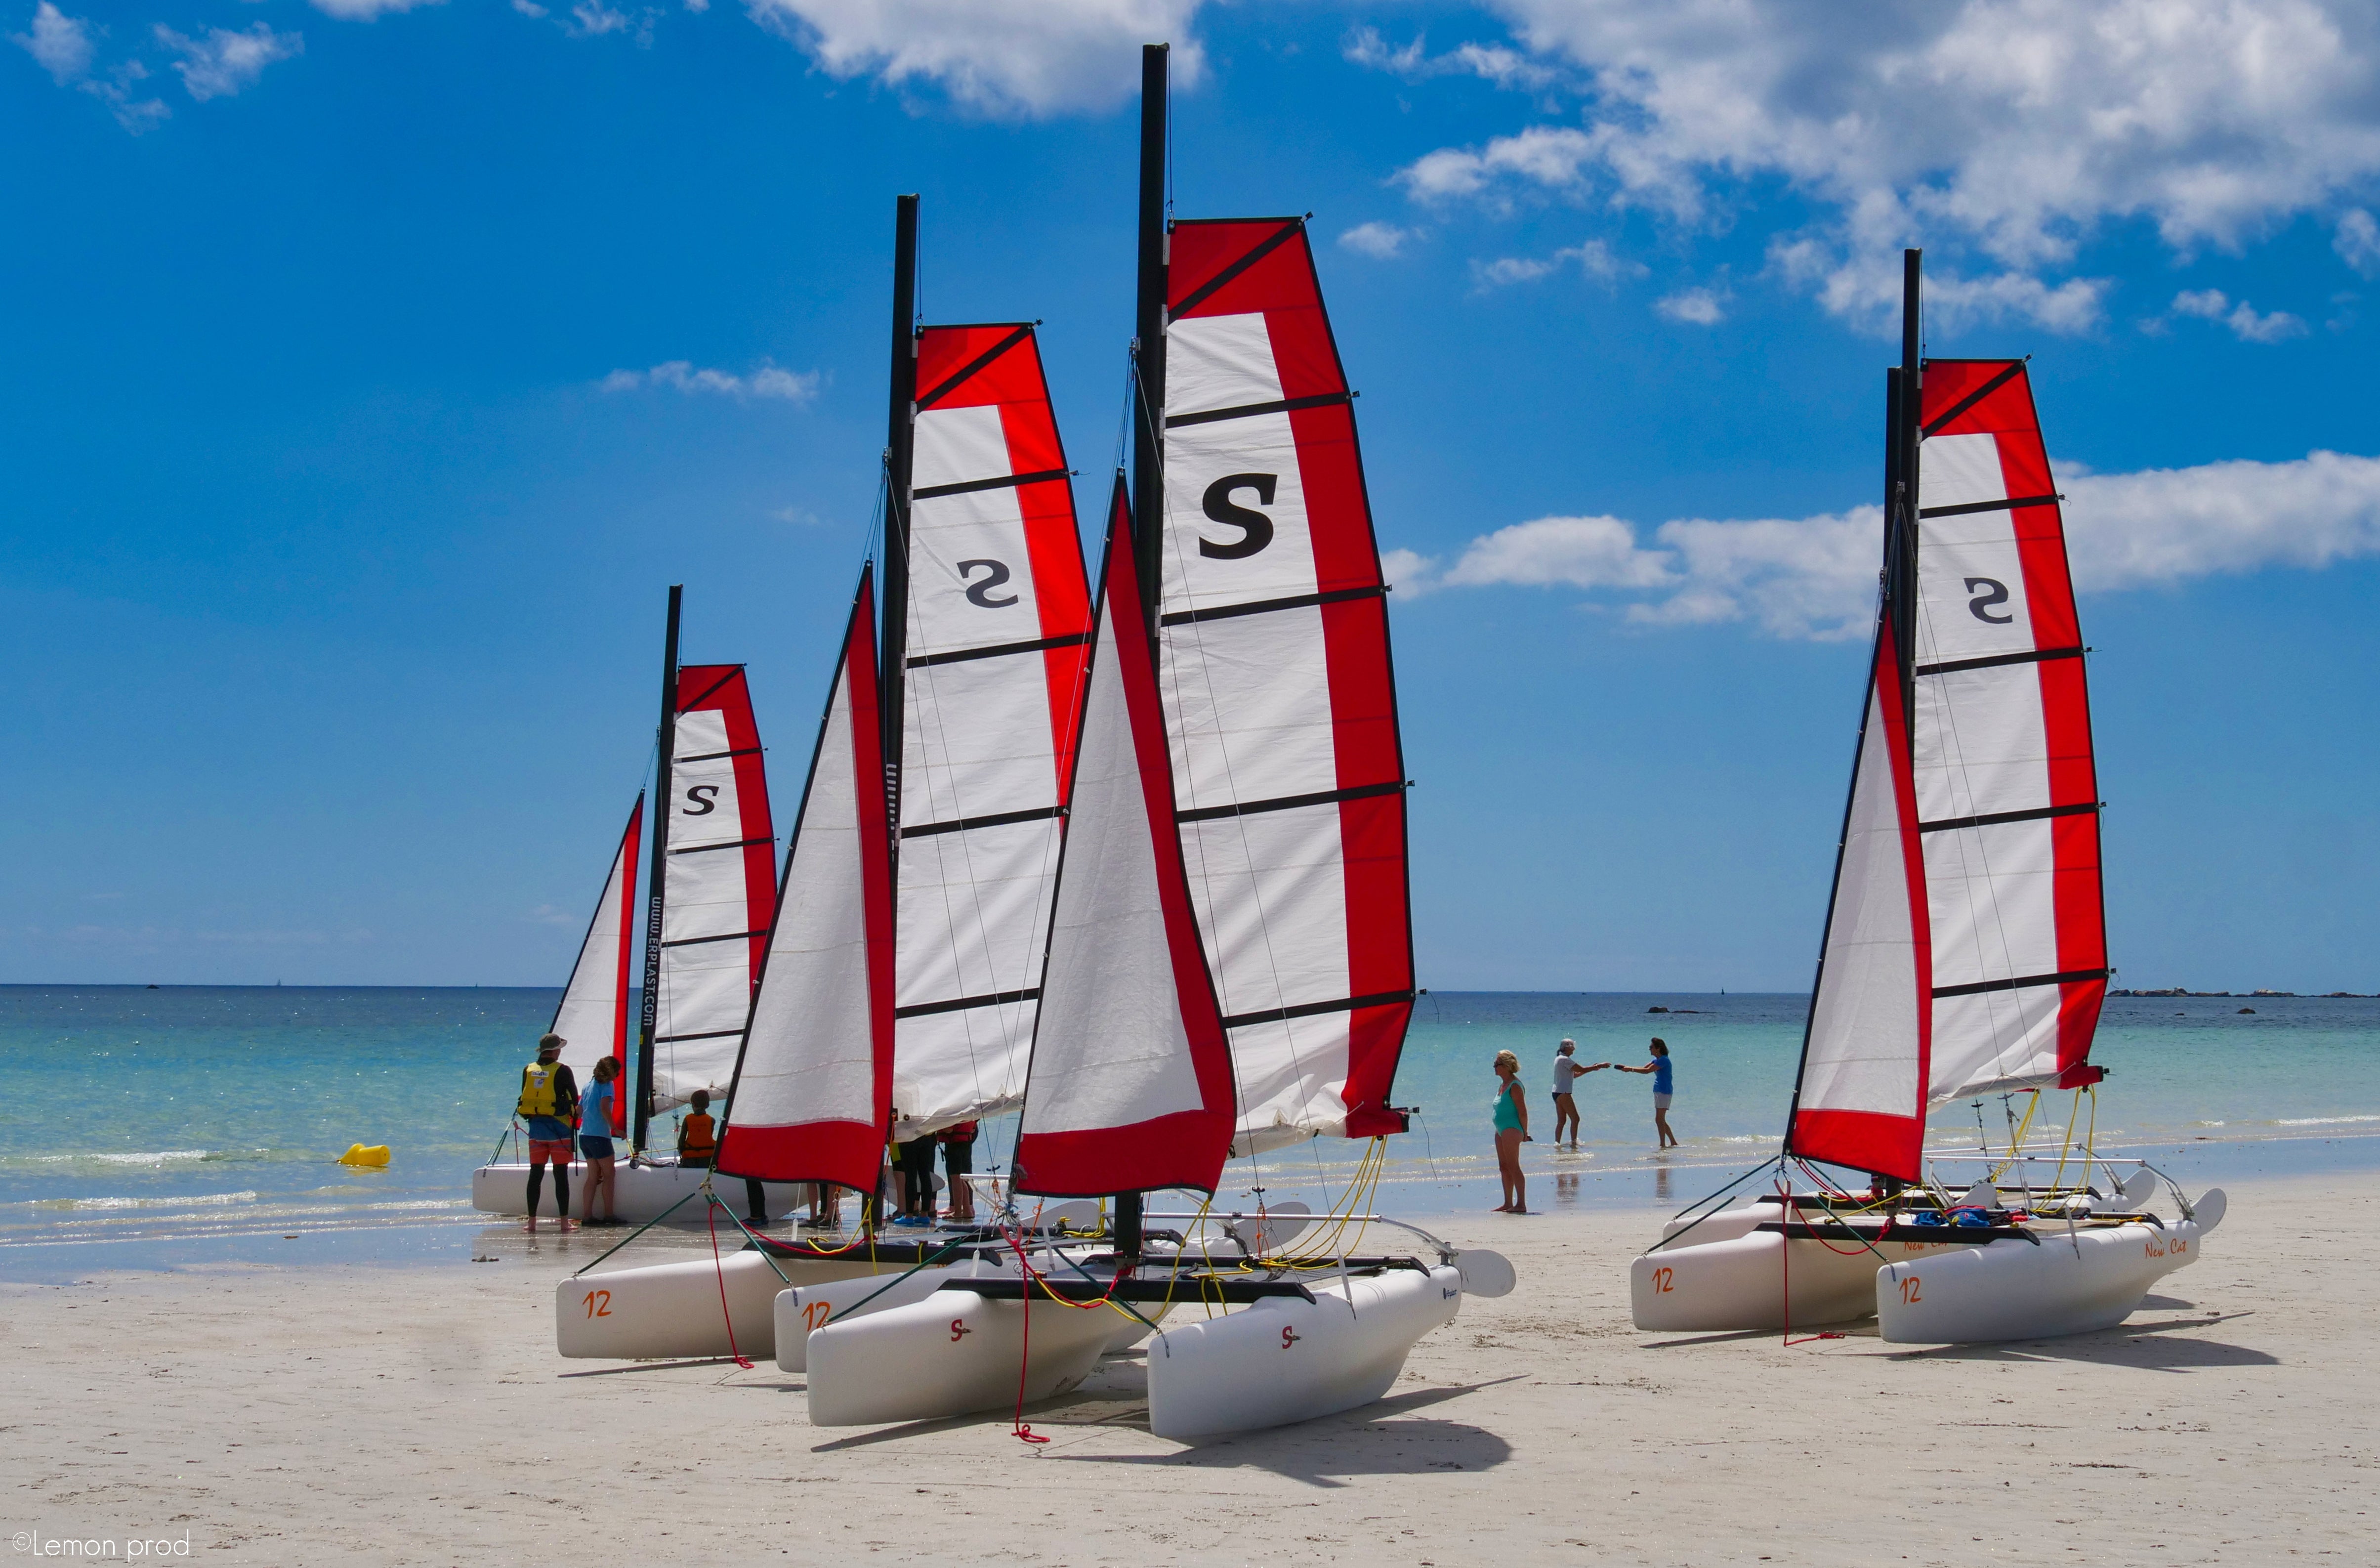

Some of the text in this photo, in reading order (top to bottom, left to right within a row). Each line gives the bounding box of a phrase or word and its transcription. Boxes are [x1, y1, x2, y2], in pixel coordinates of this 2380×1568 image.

[1199, 473, 1278, 559] S
[683, 785, 719, 816] S
[1652, 1267, 1674, 1295] 12
[1899, 1276, 1921, 1305] 12
[582, 1290, 612, 1319] 12
[801, 1301, 831, 1332] 12
